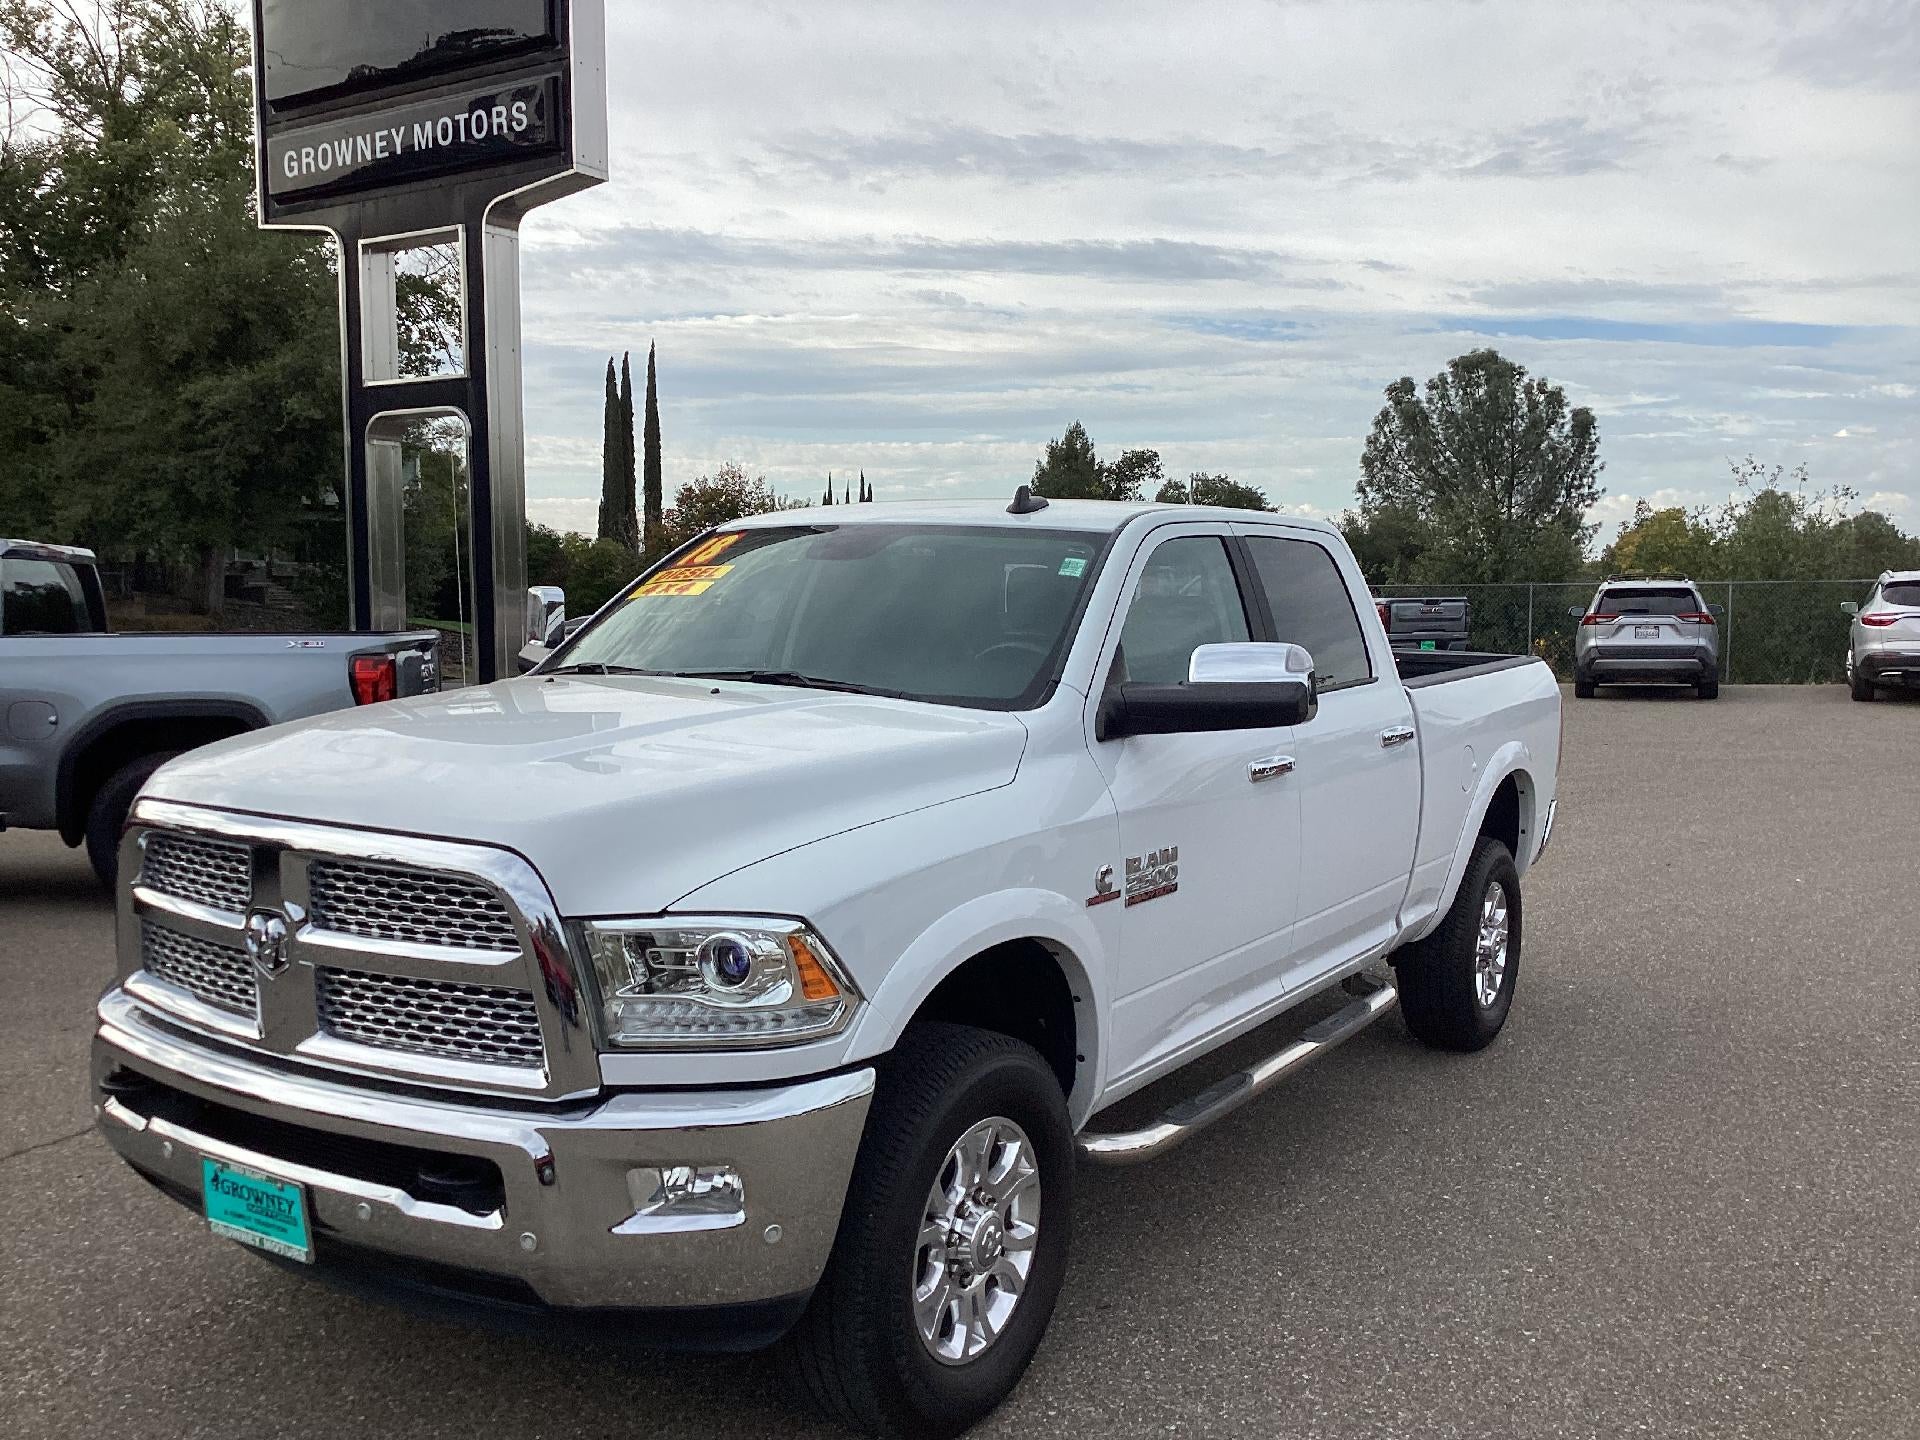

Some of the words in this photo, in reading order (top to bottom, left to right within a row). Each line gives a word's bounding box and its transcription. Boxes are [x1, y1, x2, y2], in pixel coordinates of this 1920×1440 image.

[283, 126, 405, 178] GROWNEY
[413, 101, 529, 152] MOTORS
[657, 567, 718, 582] DIESEL
[1125, 845, 1178, 876] RAM
[220, 1178, 295, 1216] GROWNEY
